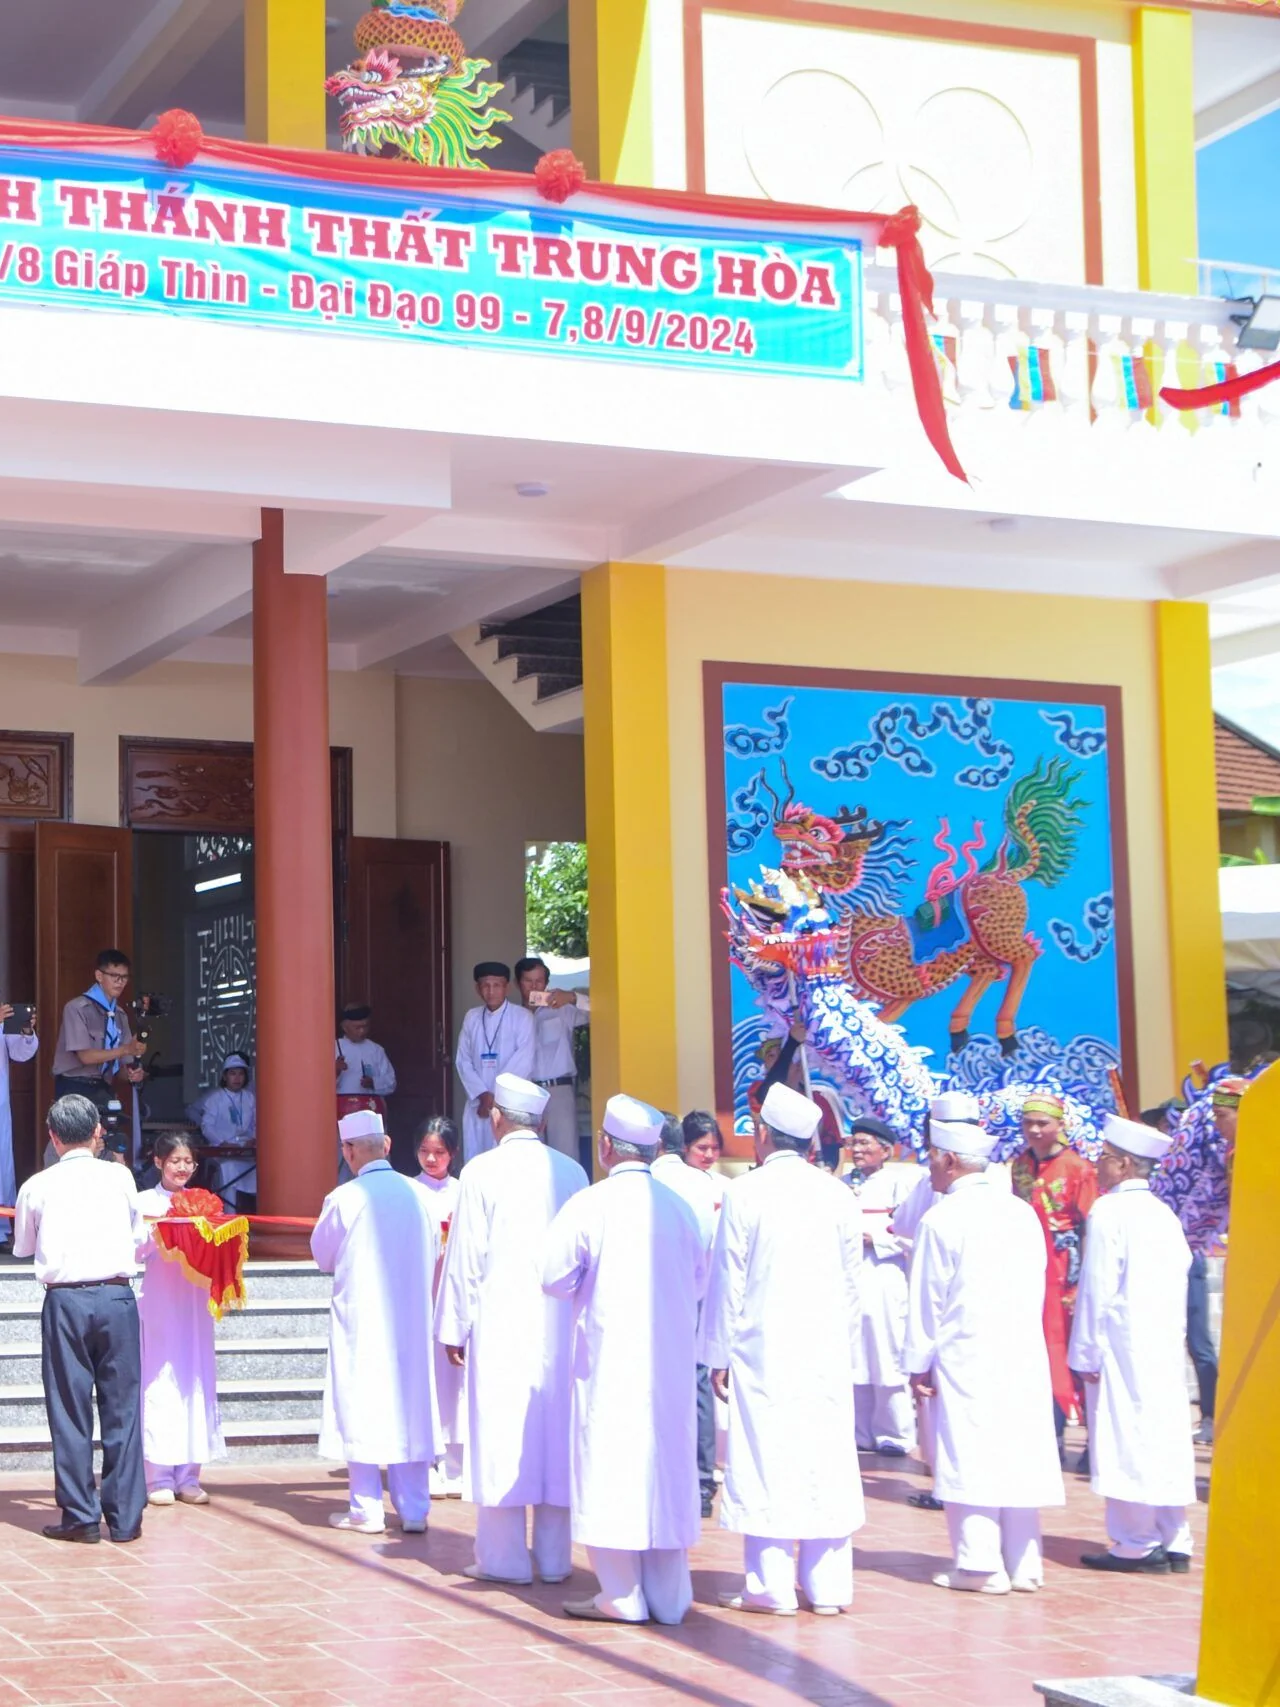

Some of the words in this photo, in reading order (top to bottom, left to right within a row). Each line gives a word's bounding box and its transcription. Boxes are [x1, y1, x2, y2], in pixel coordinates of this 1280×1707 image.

[55, 249, 146, 297] Giáp
[161, 259, 248, 303] Thìn
[290, 274, 354, 321] Đại
[368, 283, 440, 329] Đạo
[455, 293, 501, 331] 99
[60, 180, 287, 248] THÁNH
[308, 211, 471, 268] THẤT
[492, 233, 698, 290] TRUNG
[718, 251, 836, 306] HÒA
